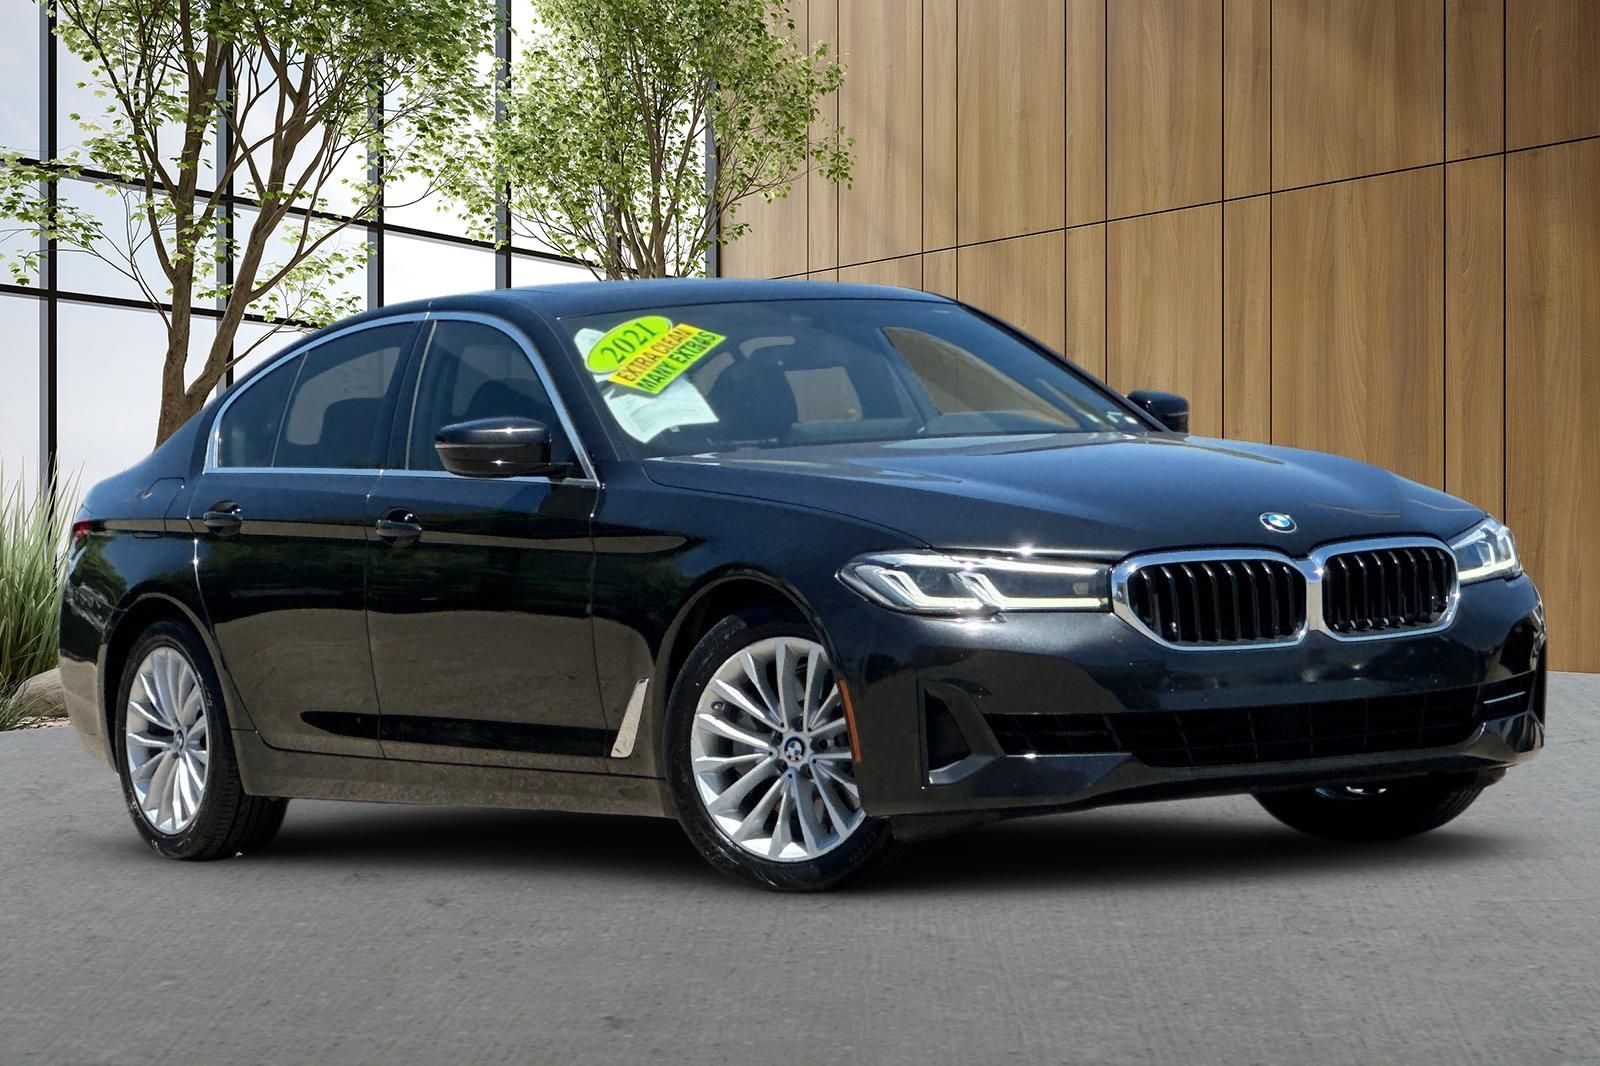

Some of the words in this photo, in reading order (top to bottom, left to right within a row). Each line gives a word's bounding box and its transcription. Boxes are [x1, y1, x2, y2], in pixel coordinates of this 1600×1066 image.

[601, 322, 657, 364] 2021
[617, 352, 662, 382] EXTRA
[651, 328, 693, 355] CLEAN
[636, 361, 678, 391] MANY
[668, 331, 717, 364] EXTRAS
